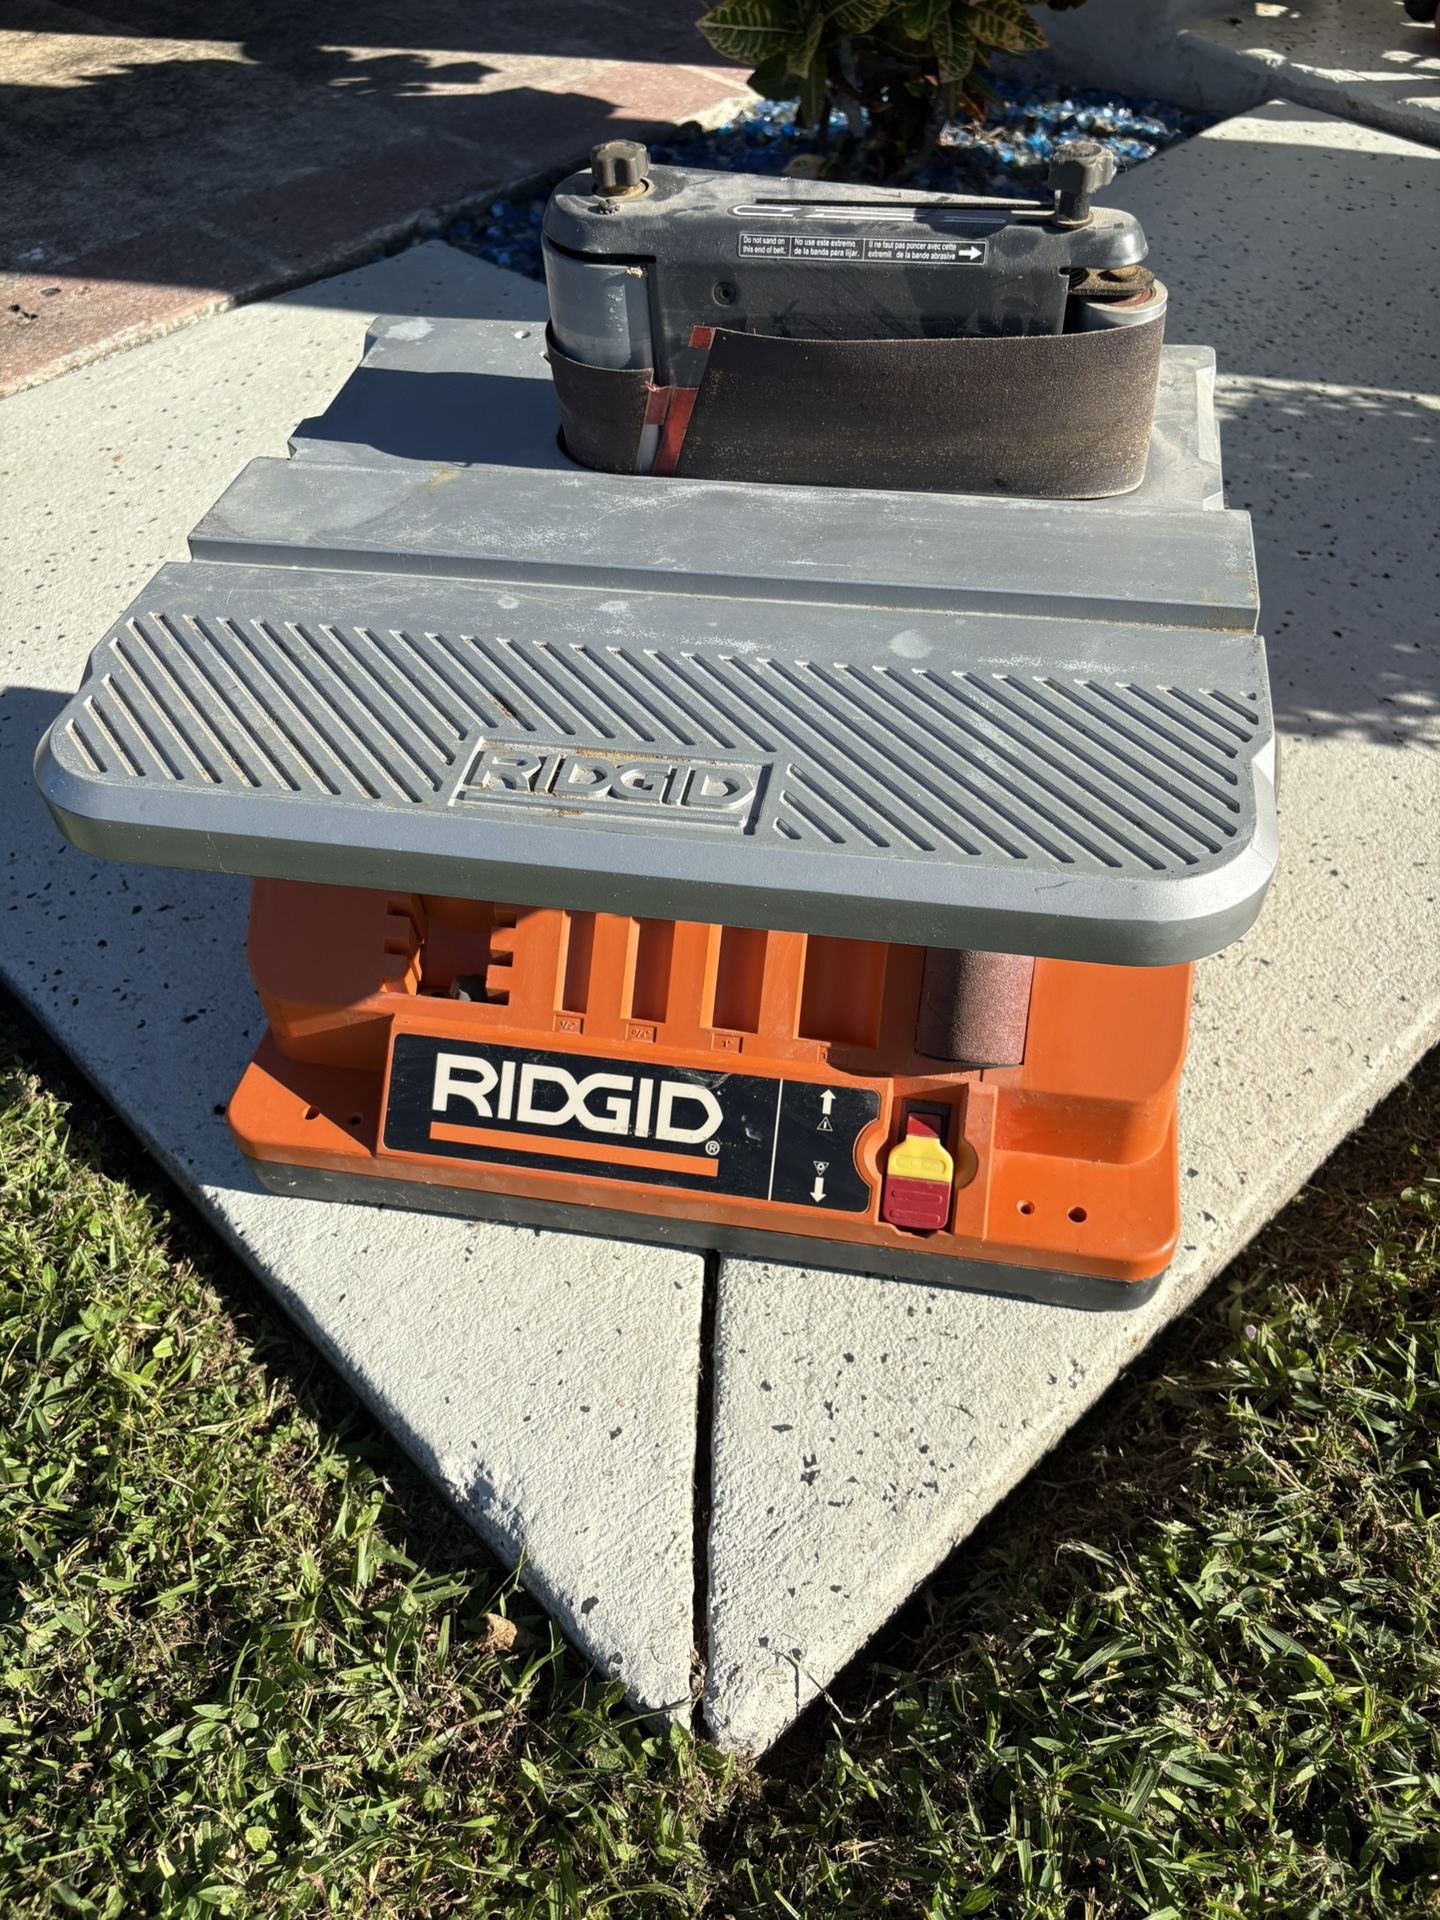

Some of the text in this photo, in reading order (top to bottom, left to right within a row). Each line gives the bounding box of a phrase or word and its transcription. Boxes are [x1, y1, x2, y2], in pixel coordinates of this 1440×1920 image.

[743, 236, 751, 244] Do
[762, 237, 777, 245] sand
[794, 238, 803, 246] No
[816, 239, 829, 247] este
[882, 240, 894, 249] faut
[894, 242, 905, 251] pas
[906, 242, 927, 251] poncer
[941, 243, 957, 251] cette
[742, 245, 753, 253] this
[754, 245, 765, 253] end
[766, 245, 772, 254] of
[810, 248, 829, 256] banda
[830, 249, 844, 257] para
[845, 249, 860, 258] lijar.
[896, 250, 904, 259] de
[904, 251, 911, 259] la
[911, 251, 930, 260] bande
[930, 251, 956, 260] abrasive
[464, 749, 755, 810] RIDGID
[431, 1051, 724, 1145] RIDGID
